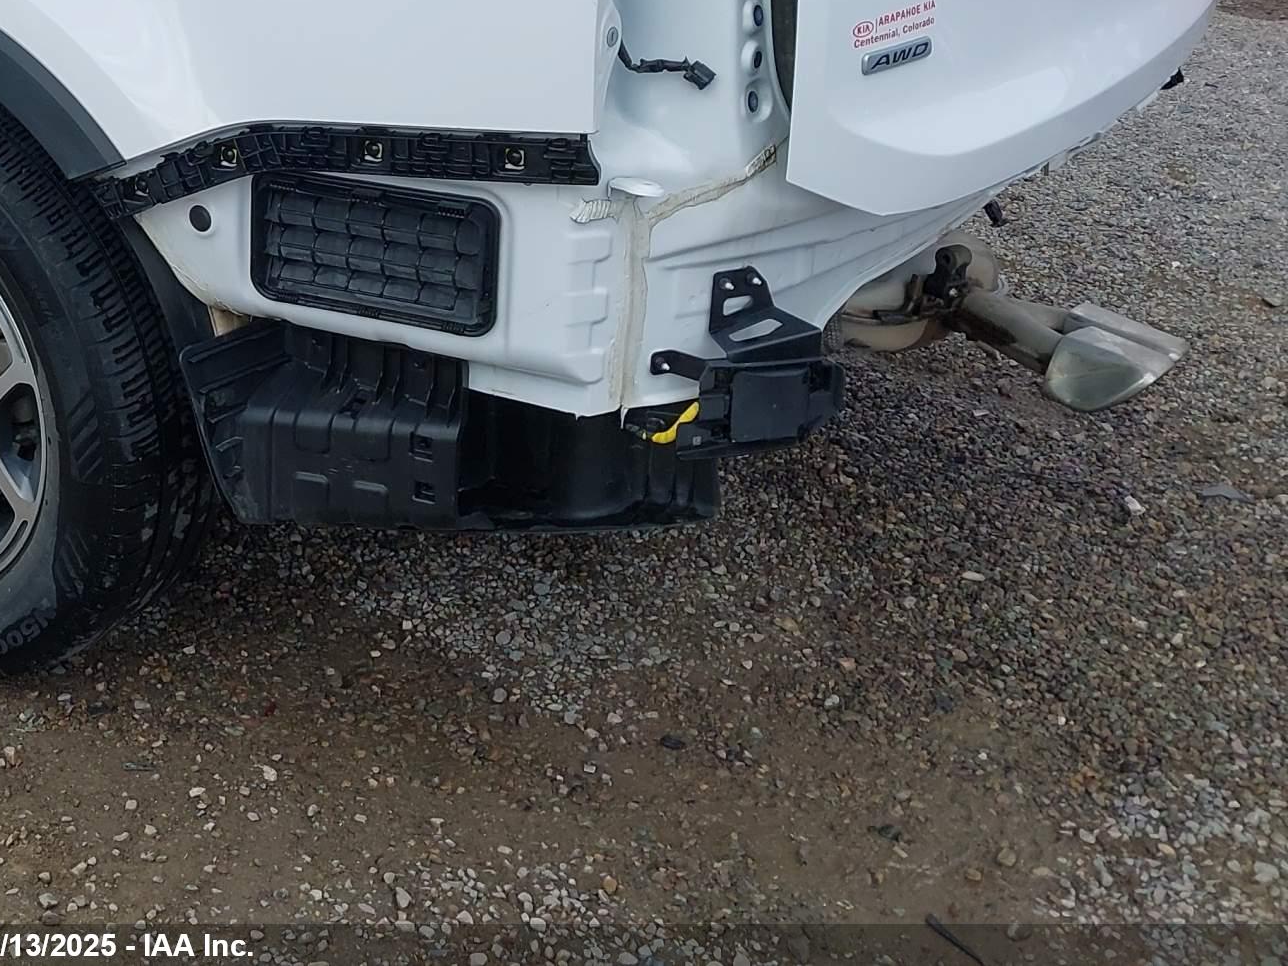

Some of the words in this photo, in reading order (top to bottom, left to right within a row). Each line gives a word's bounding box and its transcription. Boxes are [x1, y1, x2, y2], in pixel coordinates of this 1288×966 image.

[878, 4, 921, 26] ARAPAHOE
[923, 0, 936, 11] KIA
[854, 29, 900, 48] Centennial,
[902, 17, 935, 34] Colorado
[870, 41, 930, 71] AWD
